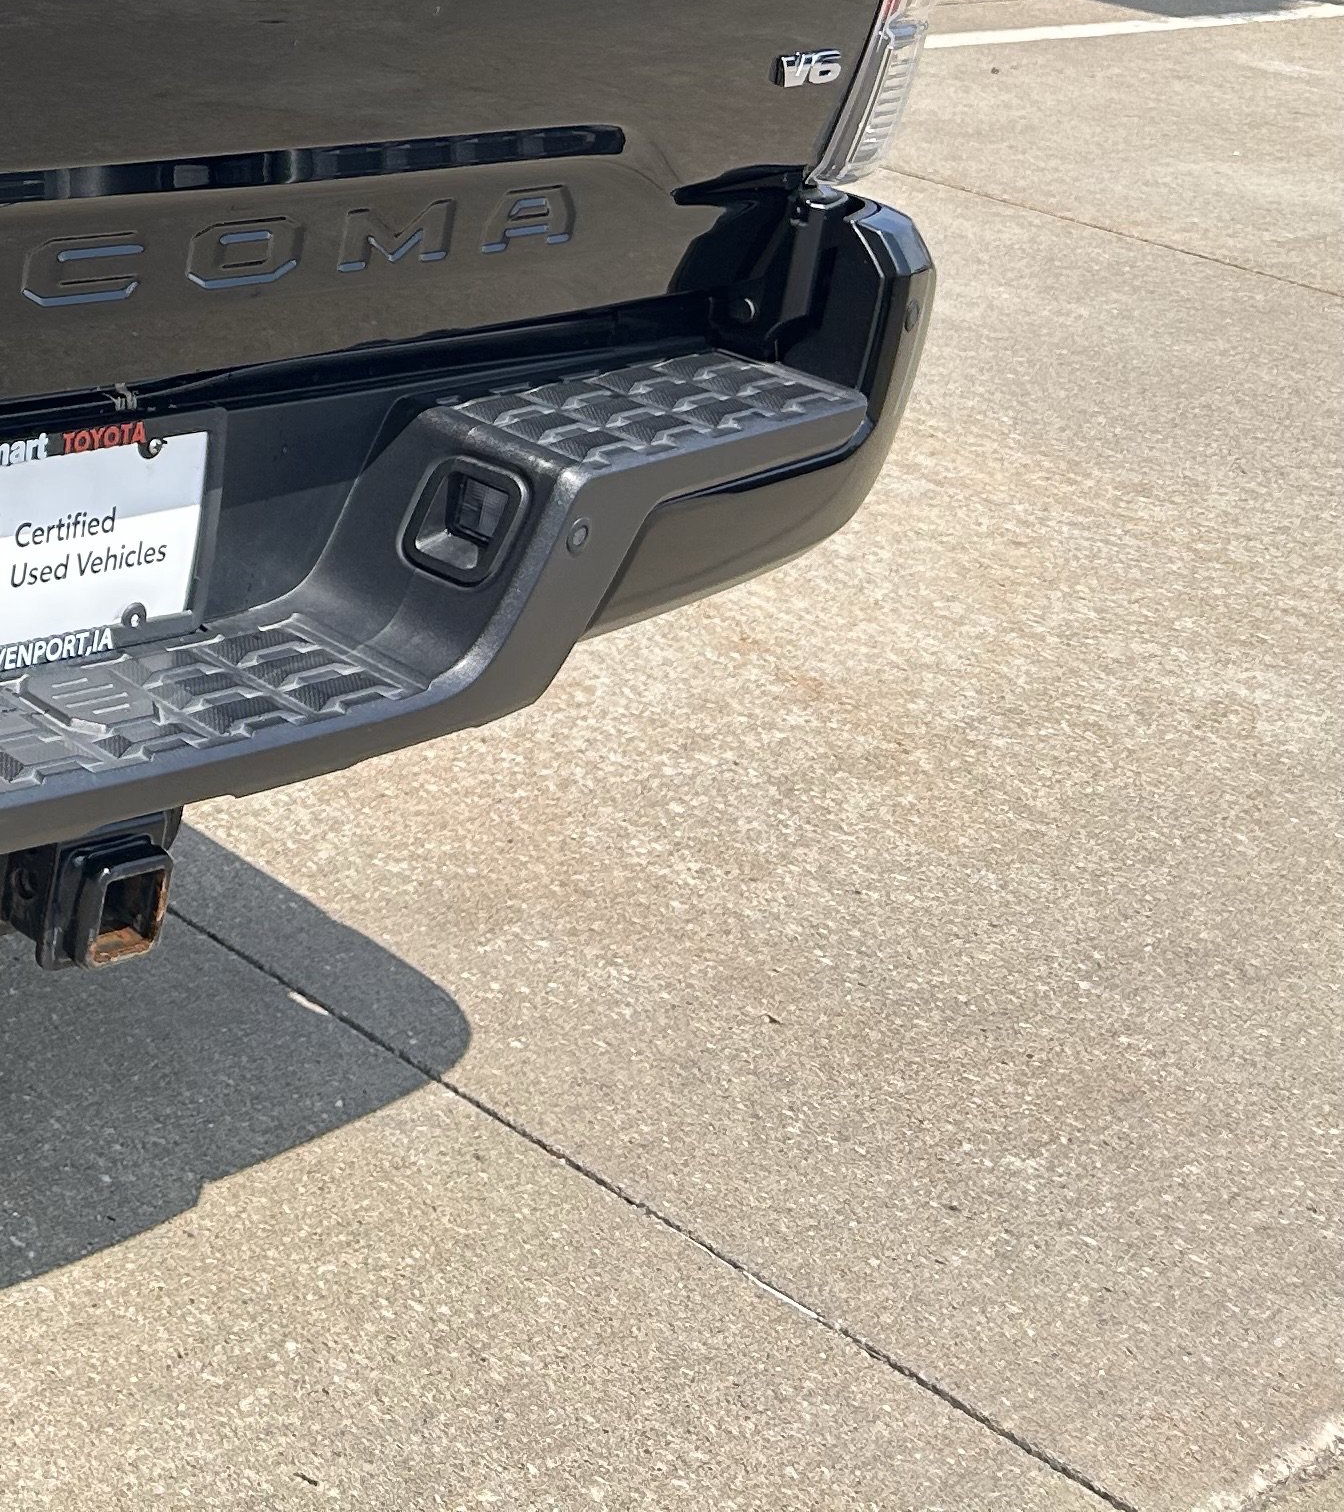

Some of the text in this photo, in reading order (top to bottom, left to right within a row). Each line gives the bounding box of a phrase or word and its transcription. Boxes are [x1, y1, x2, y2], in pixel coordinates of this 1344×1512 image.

[776, 49, 841, 88] V6
[63, 420, 147, 455] TOYOTA
[14, 506, 117, 549] Certified
[10, 541, 167, 588] Used Vehicles
